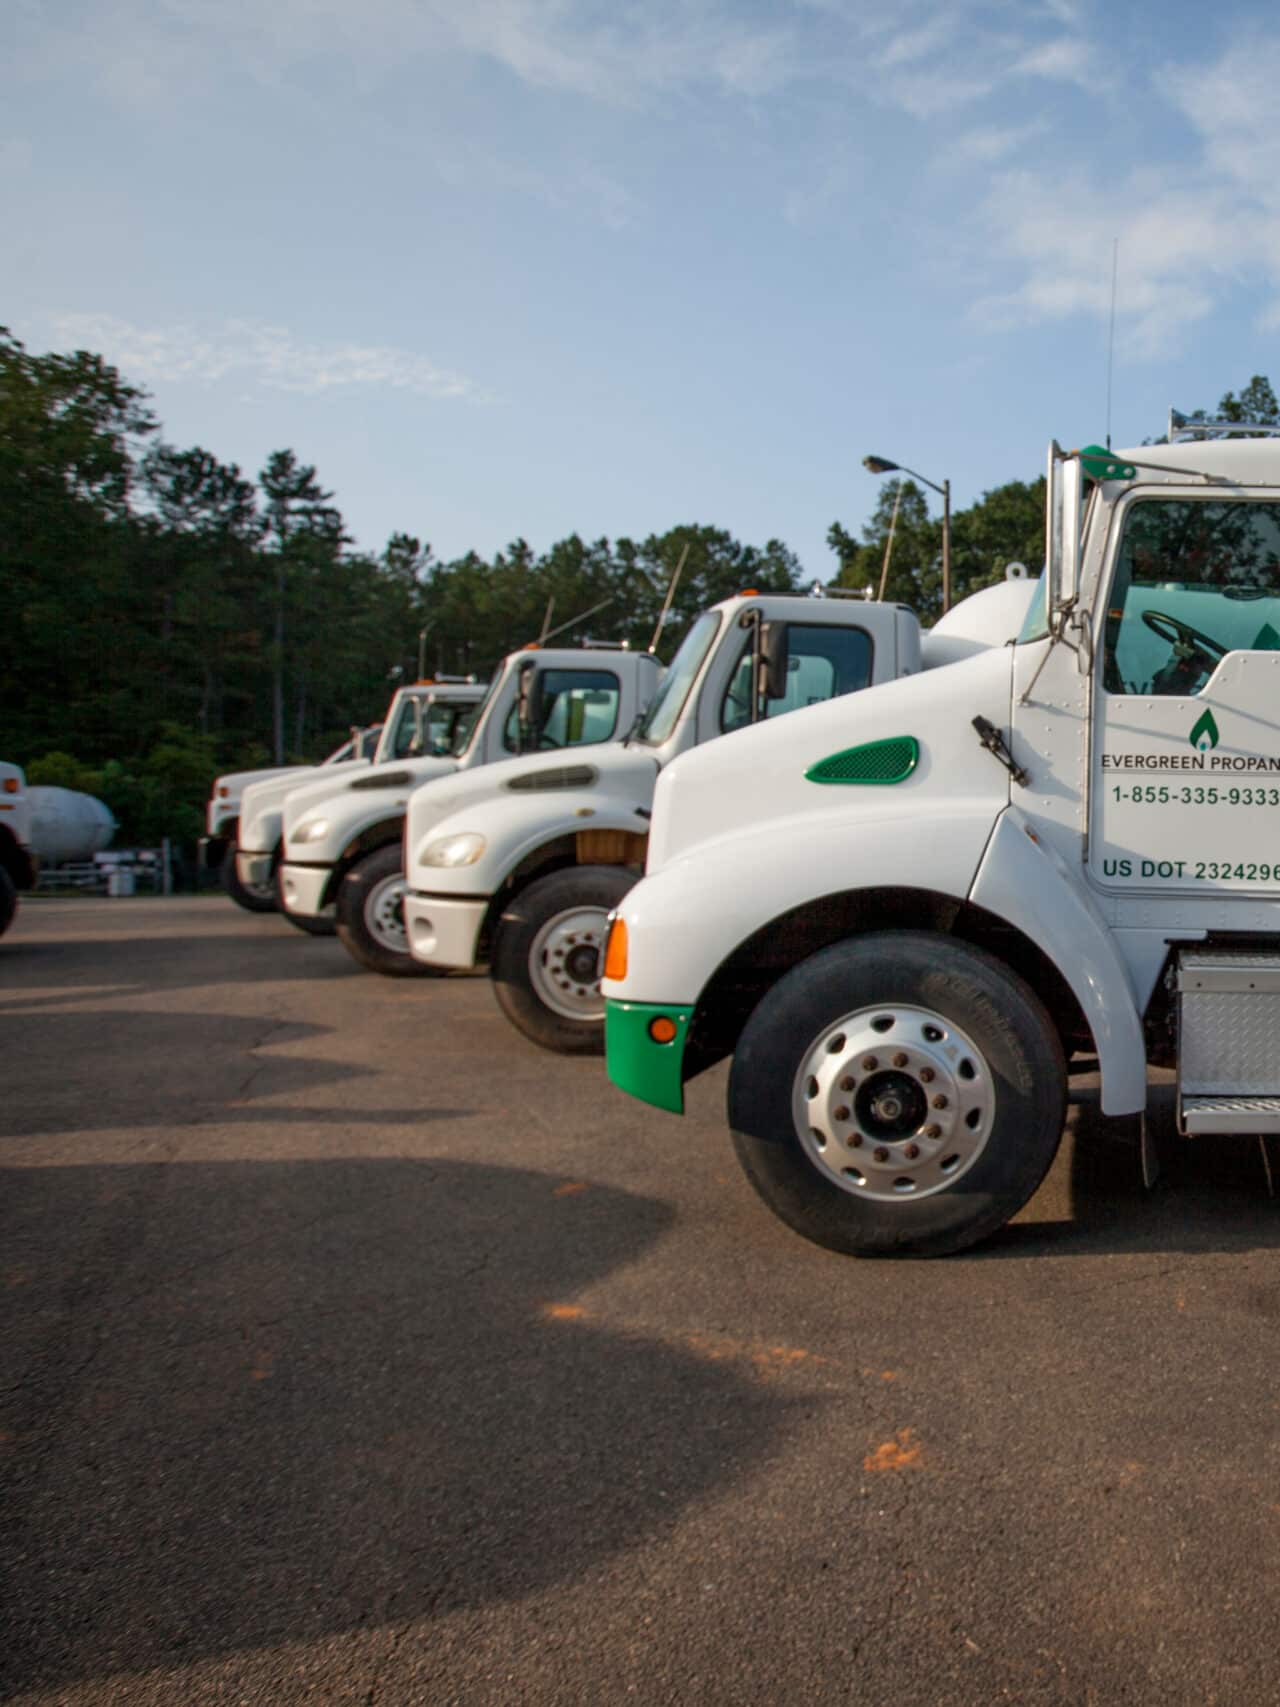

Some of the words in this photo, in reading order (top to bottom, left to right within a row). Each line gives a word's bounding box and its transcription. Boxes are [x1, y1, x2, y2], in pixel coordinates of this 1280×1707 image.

[1102, 753, 1205, 769] EVERGREEN
[1112, 785, 1280, 806] 1-855-335-9333
[1103, 859, 1132, 877] US
[1141, 861, 1187, 879] DOT
